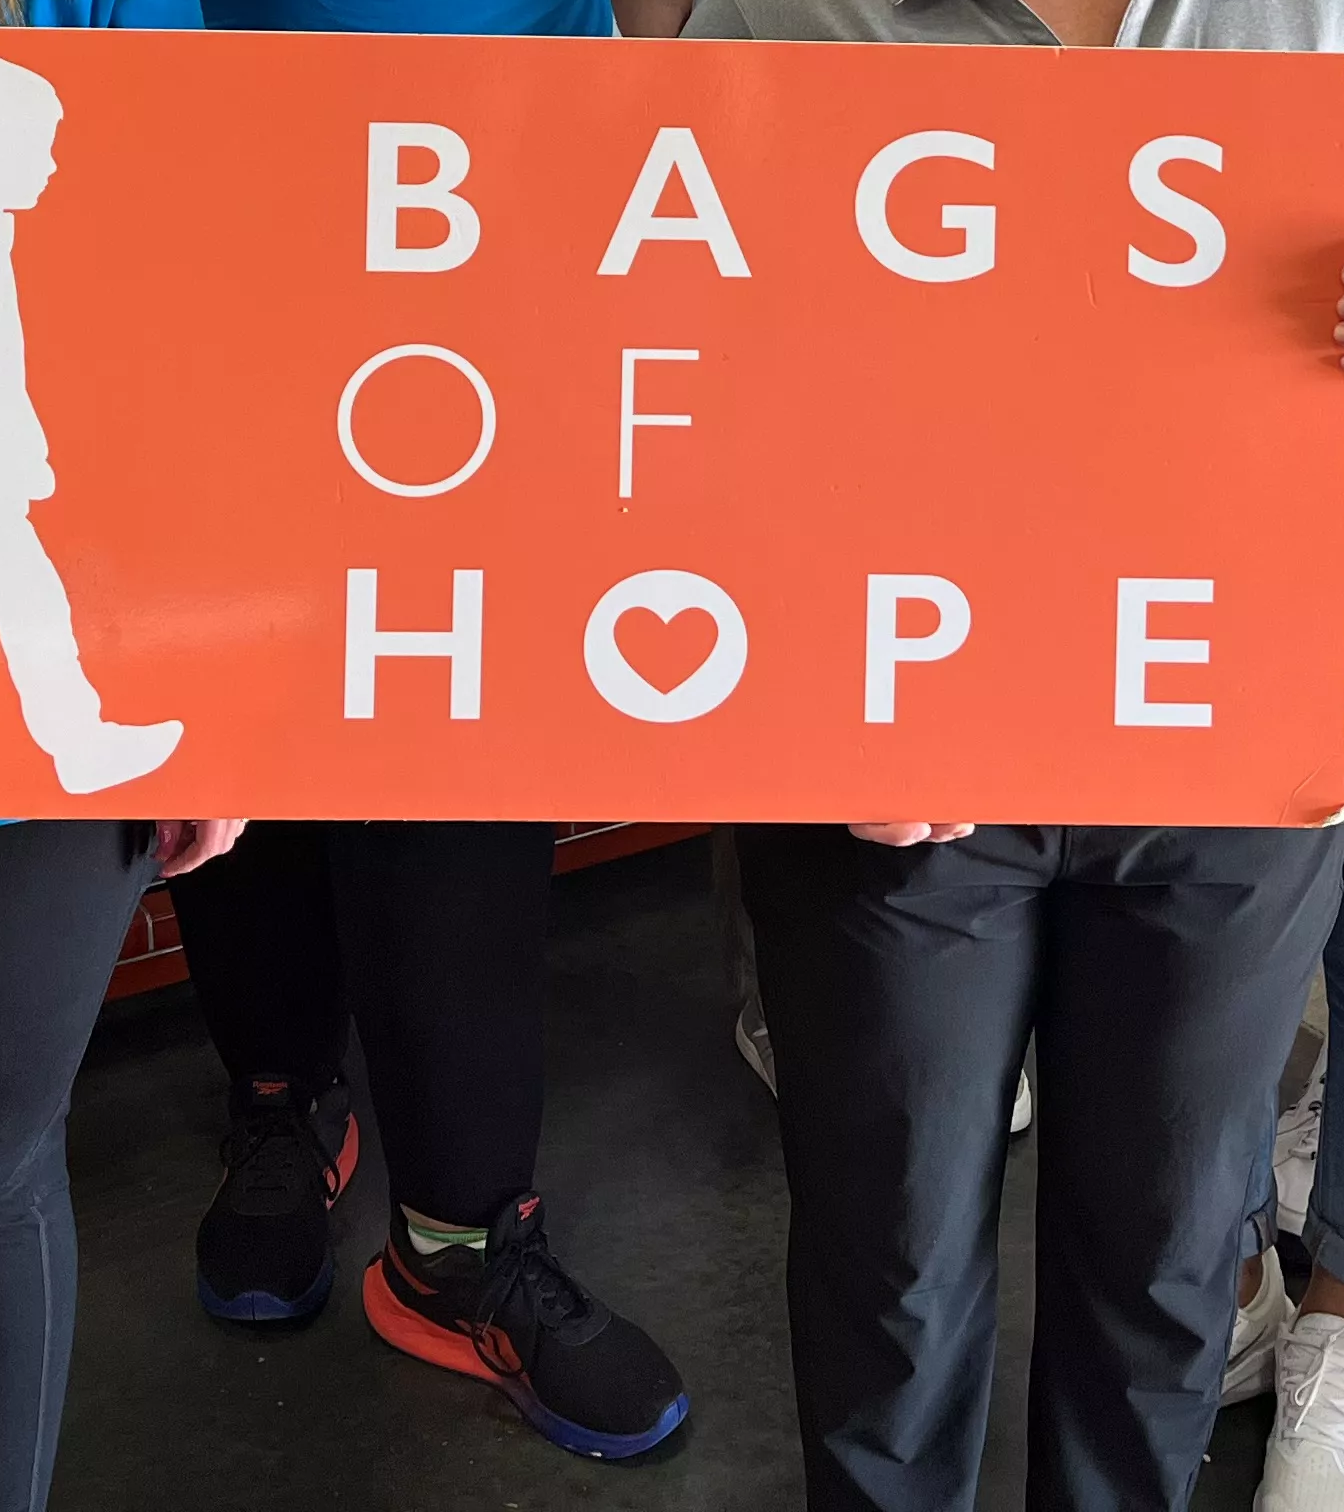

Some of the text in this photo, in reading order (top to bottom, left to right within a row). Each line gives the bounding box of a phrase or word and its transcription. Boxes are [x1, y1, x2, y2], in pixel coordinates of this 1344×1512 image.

[364, 121, 1228, 287] BAGS
[337, 343, 700, 499] OF
[343, 568, 1216, 728] HOPE
